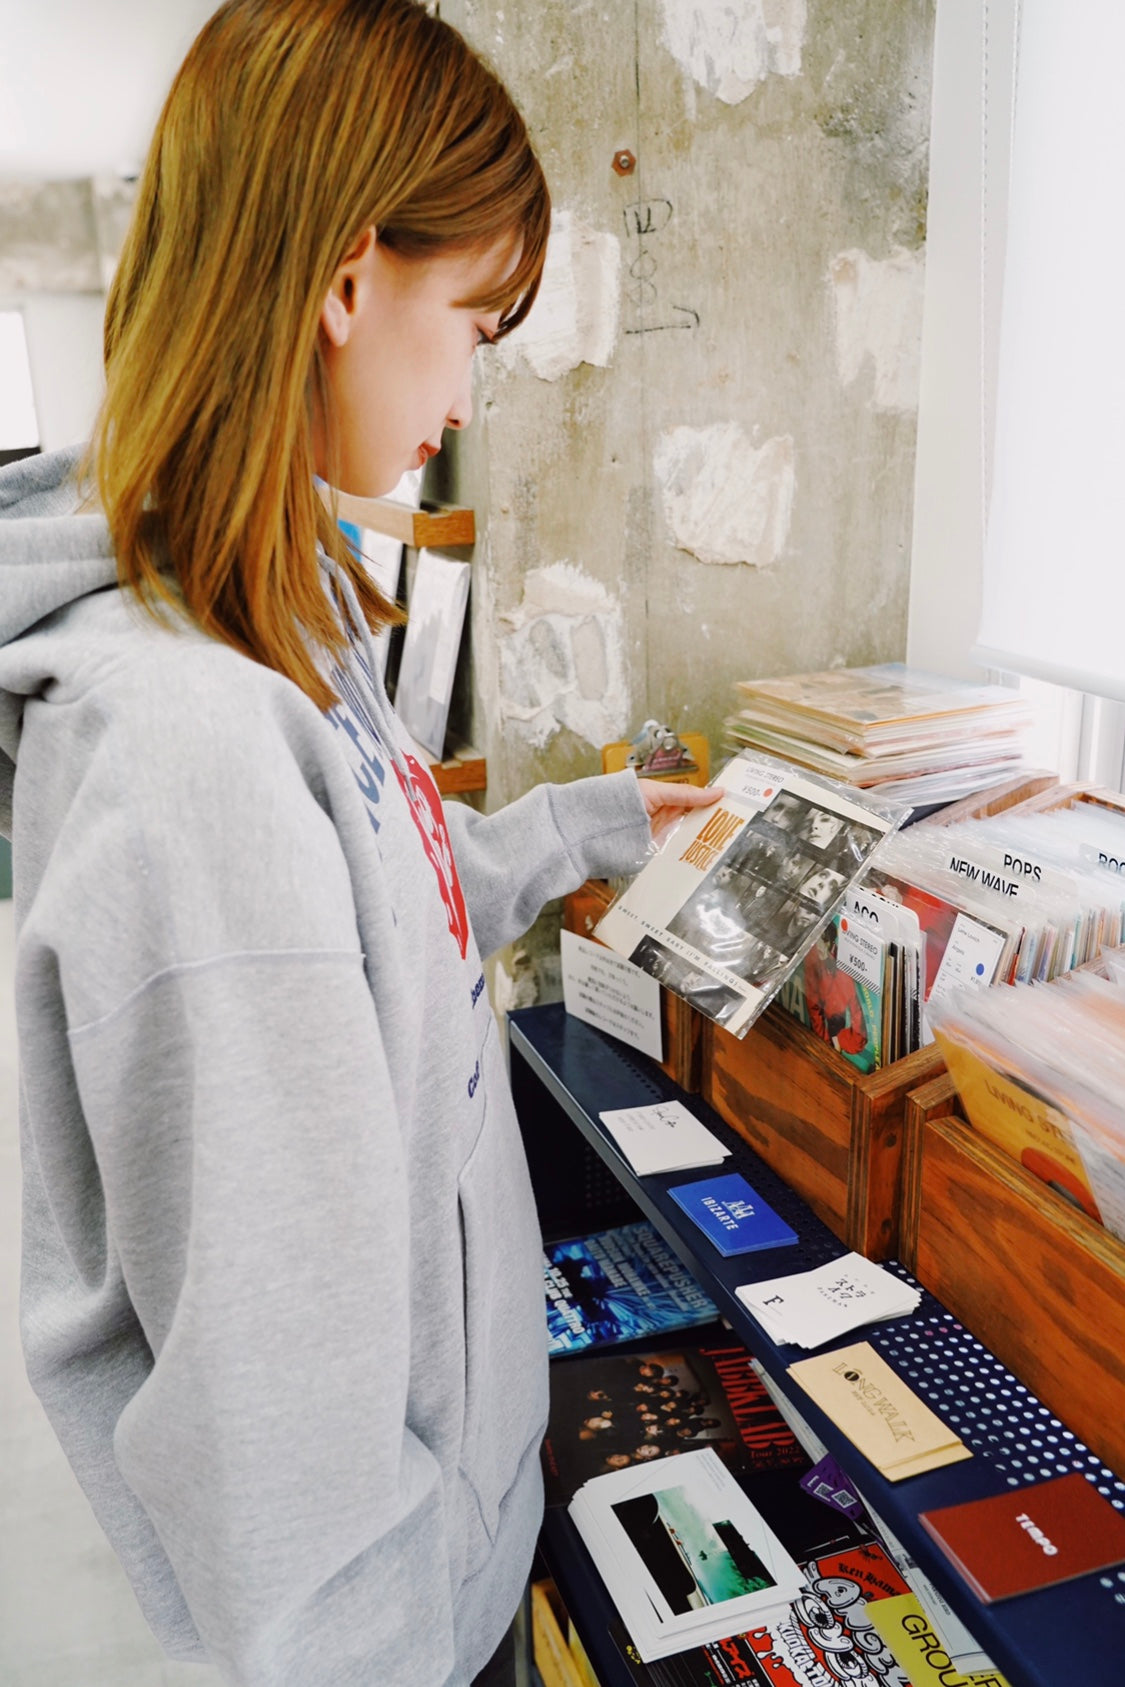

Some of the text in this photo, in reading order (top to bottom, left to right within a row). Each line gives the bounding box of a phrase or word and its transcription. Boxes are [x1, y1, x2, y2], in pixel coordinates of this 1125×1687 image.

[697, 808, 744, 851] LONE
[679, 839, 719, 872] JUSTICE
[1003, 854, 1041, 883] POPS
[701, 1196, 739, 1230] IBIZARTE
[632, 1225, 709, 1309] SQUAREPUSHER
[762, 1294, 784, 1306] F
[873, 1397, 916, 1443] WALK
